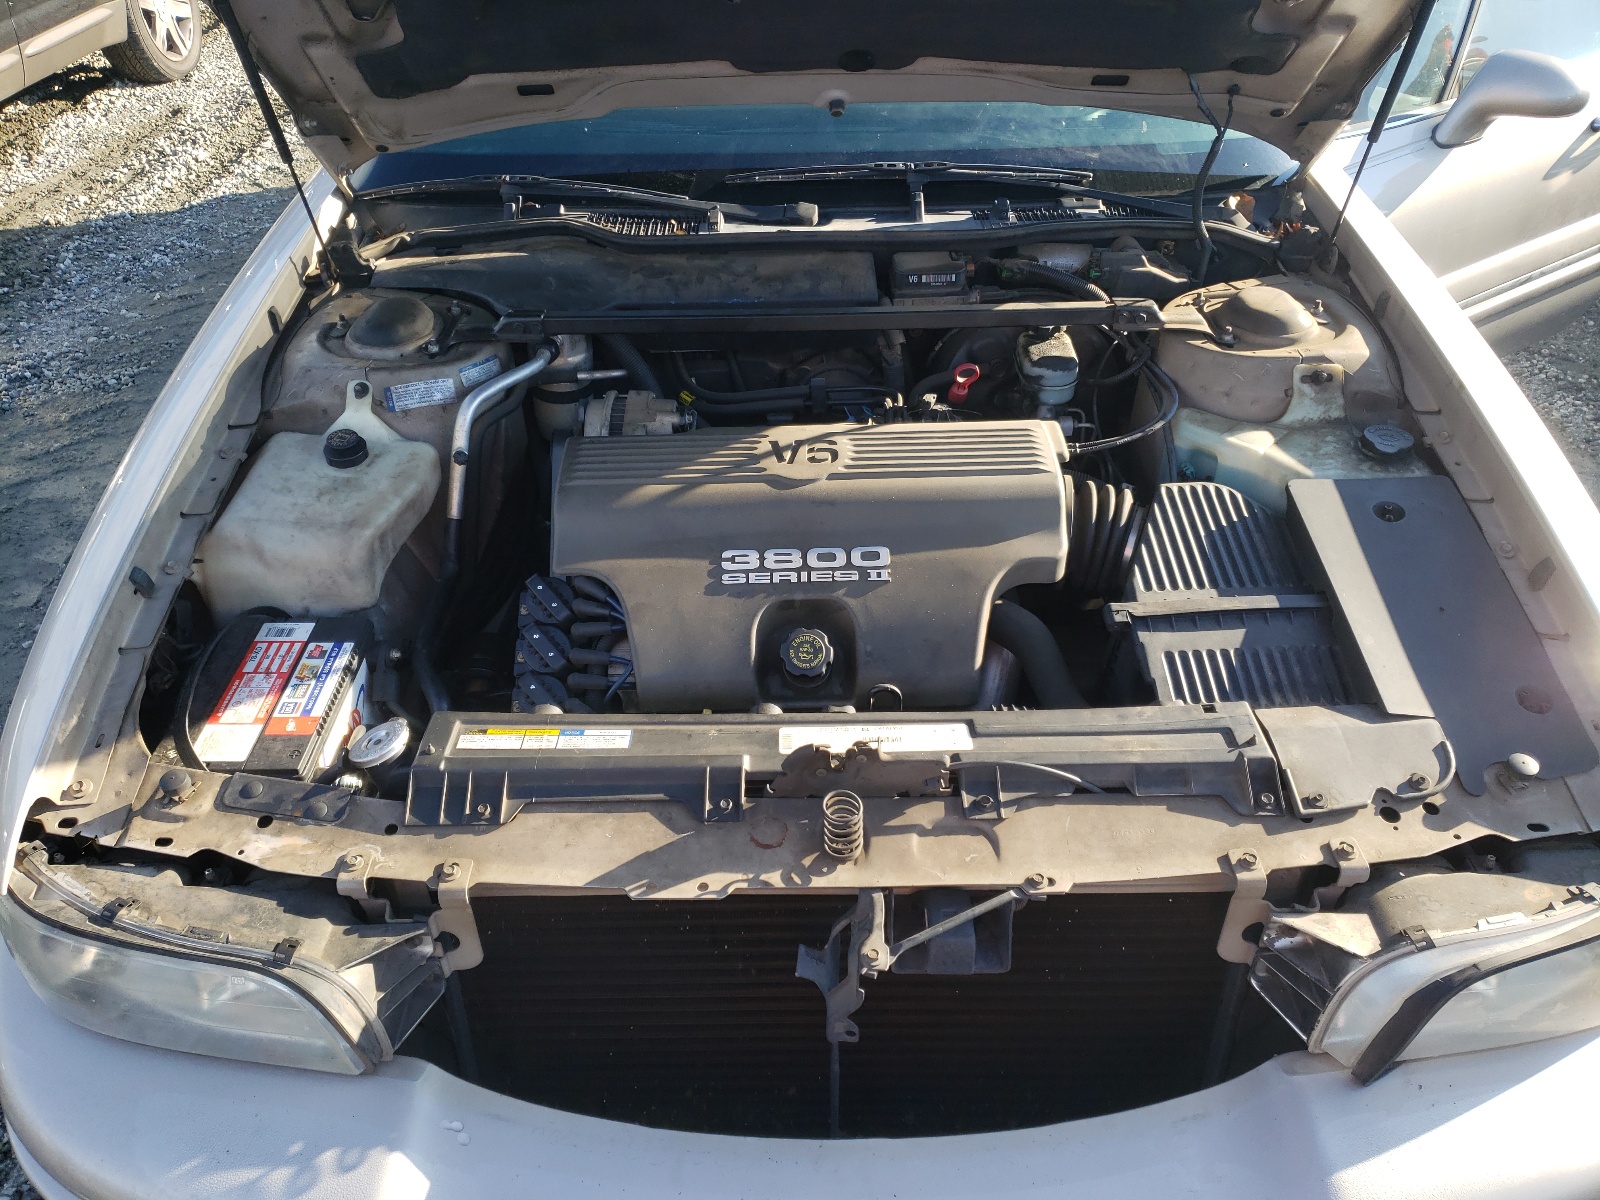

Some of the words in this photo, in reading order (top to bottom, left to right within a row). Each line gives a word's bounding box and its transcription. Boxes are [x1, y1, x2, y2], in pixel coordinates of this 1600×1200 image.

[908, 275, 918, 283] V6
[768, 439, 839, 465] V6
[721, 546, 891, 571] 3800
[721, 570, 859, 584] SERIES
[867, 569, 892, 583] II
[792, 635, 814, 647] ENGINE
